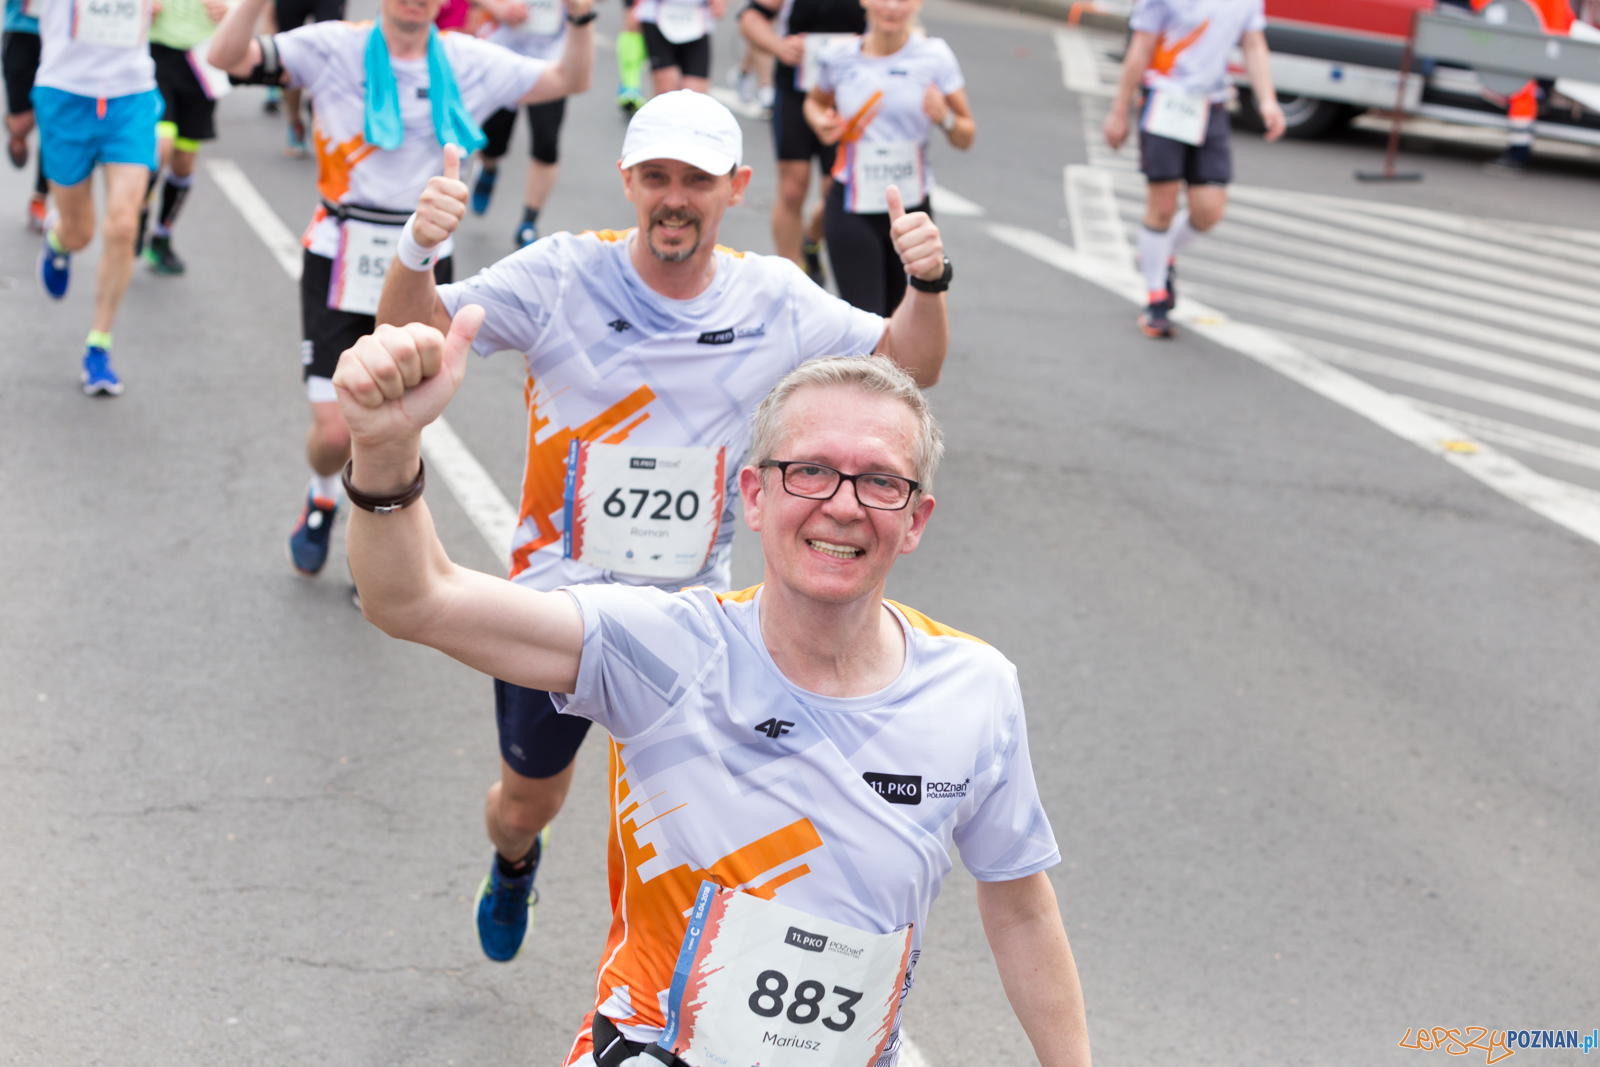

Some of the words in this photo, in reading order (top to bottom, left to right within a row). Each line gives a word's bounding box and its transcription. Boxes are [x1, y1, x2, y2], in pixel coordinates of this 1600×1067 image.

[603, 487, 699, 521] 6720
[630, 526, 669, 538] Roman
[755, 718, 795, 738] 4F
[870, 780, 885, 794] 11.
[887, 782, 917, 797] PKO
[695, 886, 711, 919] 15.04.2018
[792, 931, 802, 943] 11.
[802, 936, 823, 948] PKO
[748, 969, 864, 1032] 883
[762, 1031, 821, 1051] Mariusz
